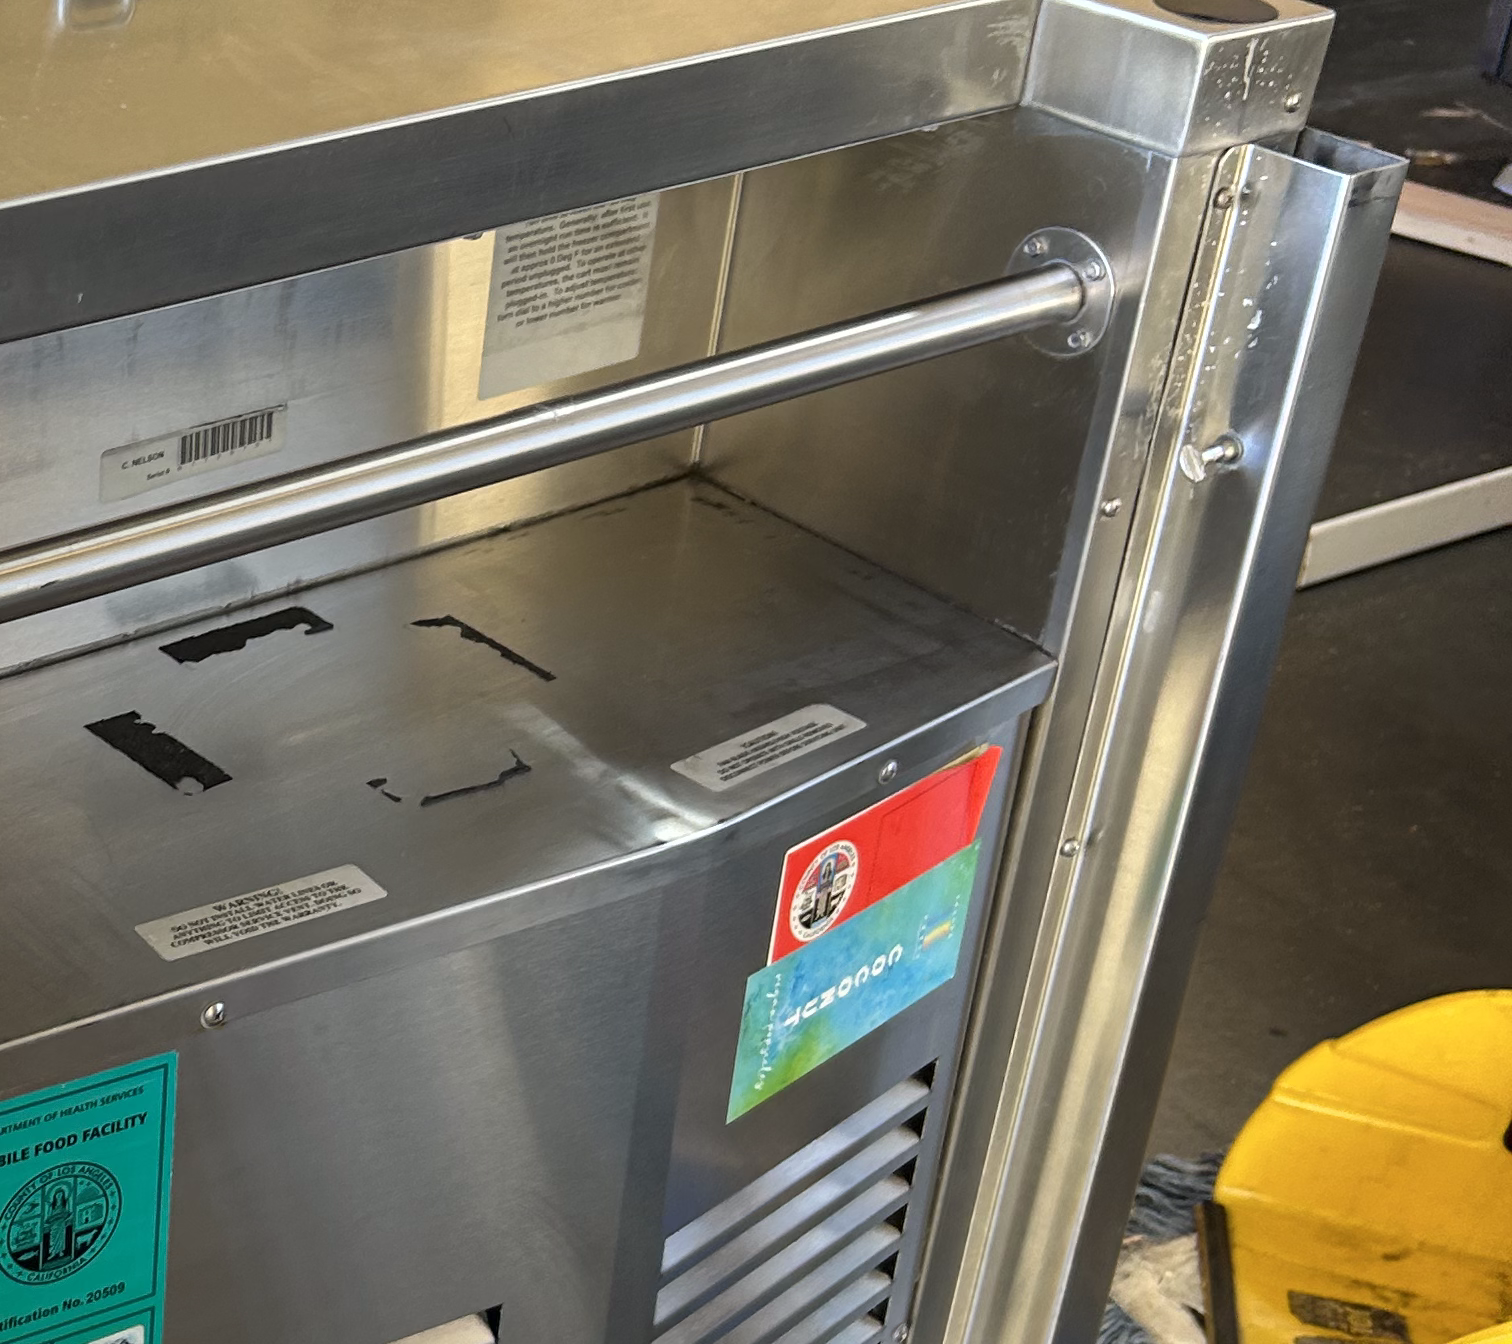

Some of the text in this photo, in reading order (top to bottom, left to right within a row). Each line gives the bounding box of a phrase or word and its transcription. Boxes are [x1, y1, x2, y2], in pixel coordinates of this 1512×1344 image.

[132, 450, 165, 466] NELSON
[212, 887, 283, 912] WARNING!
[784, 944, 904, 1028] COCONUT
[44, 1112, 58, 1122] OF
[60, 1098, 98, 1117] HEALTH
[99, 1085, 144, 1106] SERVICES
[34, 1134, 78, 1157] FOOD
[82, 1111, 148, 1142] FACILITY
[26, 1257, 88, 1281] CALIFORNIA
[62, 1296, 83, 1312] No.
[85, 1282, 126, 1305] 20509
